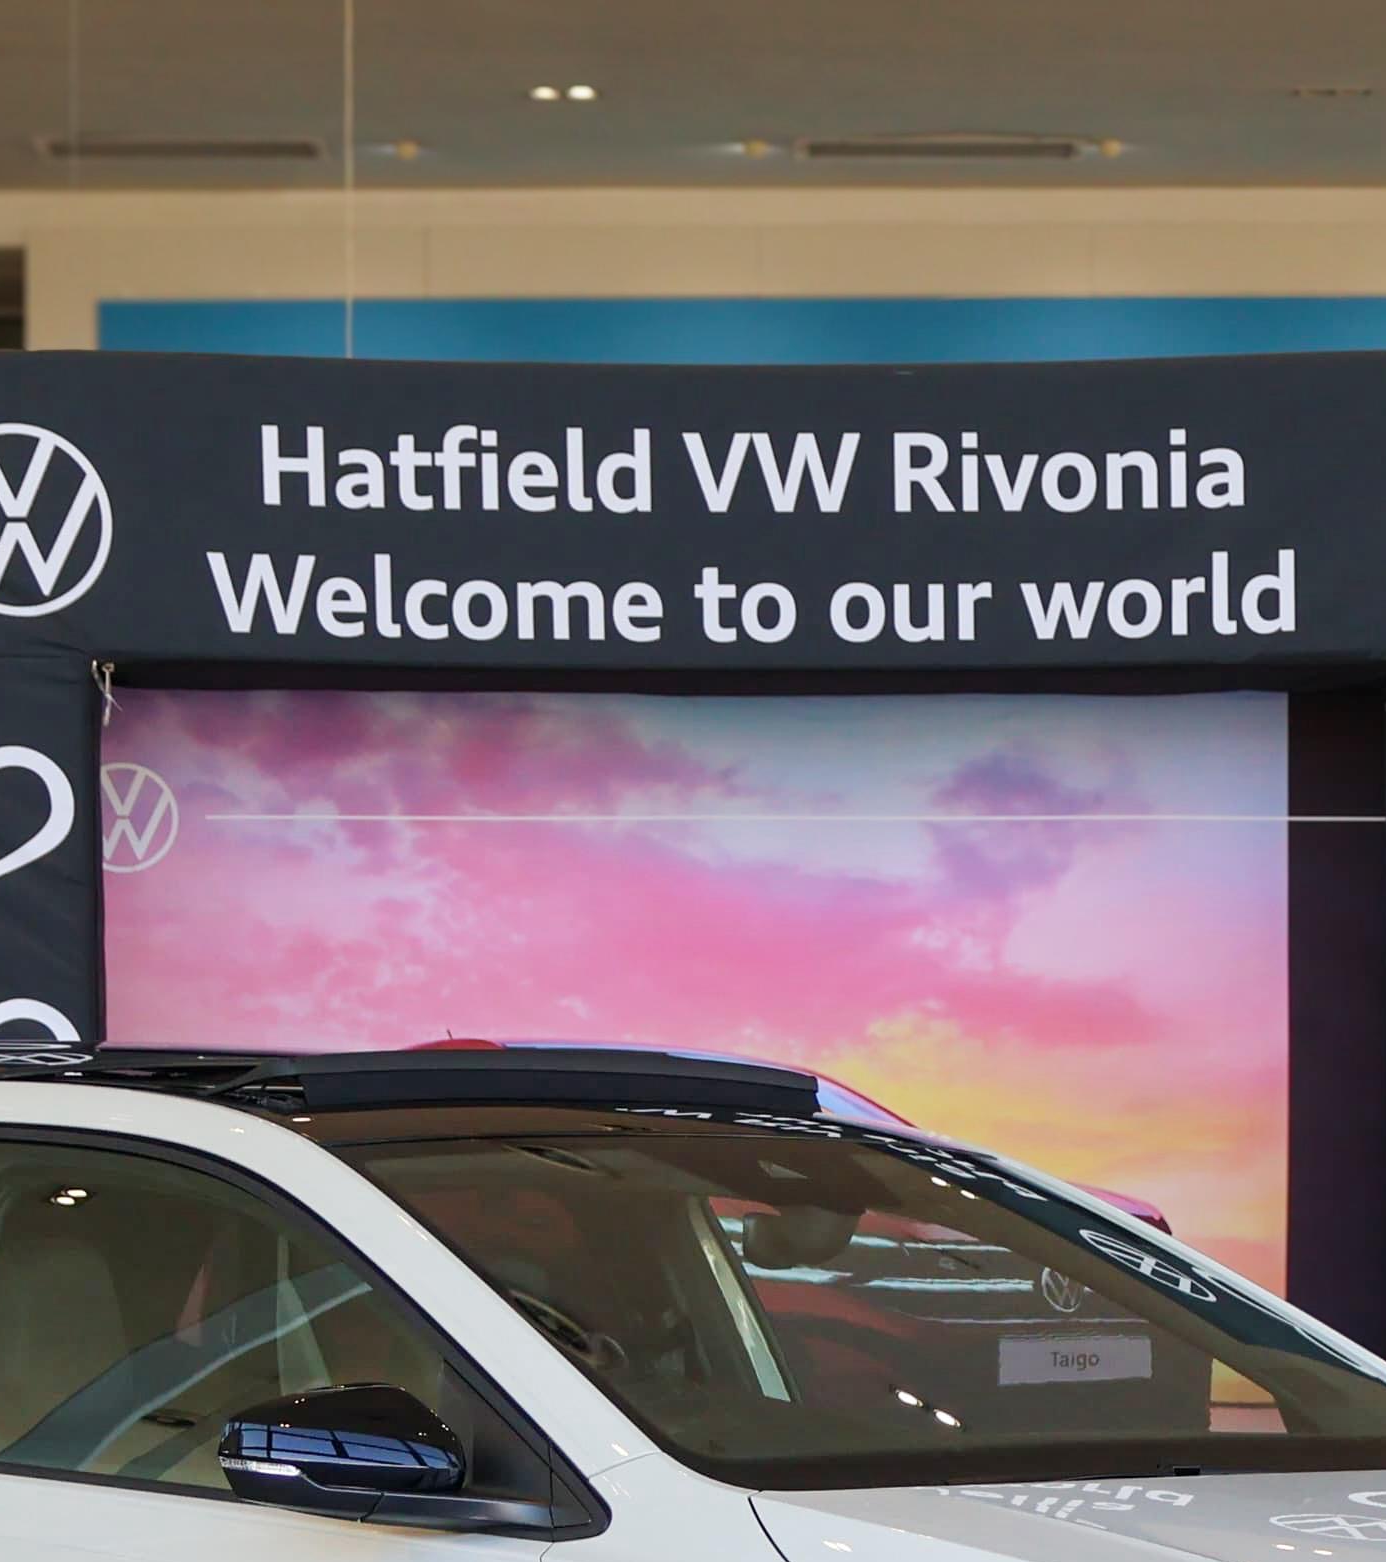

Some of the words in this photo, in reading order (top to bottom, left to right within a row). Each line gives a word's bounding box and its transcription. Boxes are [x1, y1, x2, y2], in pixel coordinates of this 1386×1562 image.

[261, 424, 652, 513] Hatfield
[682, 431, 861, 514] VW
[893, 428, 1246, 514] Rivonia
[206, 551, 664, 643] Welcome
[694, 566, 797, 643] to
[829, 580, 993, 643] our
[1020, 548, 1297, 640] world
[1050, 1351, 1101, 1372] Taigo
